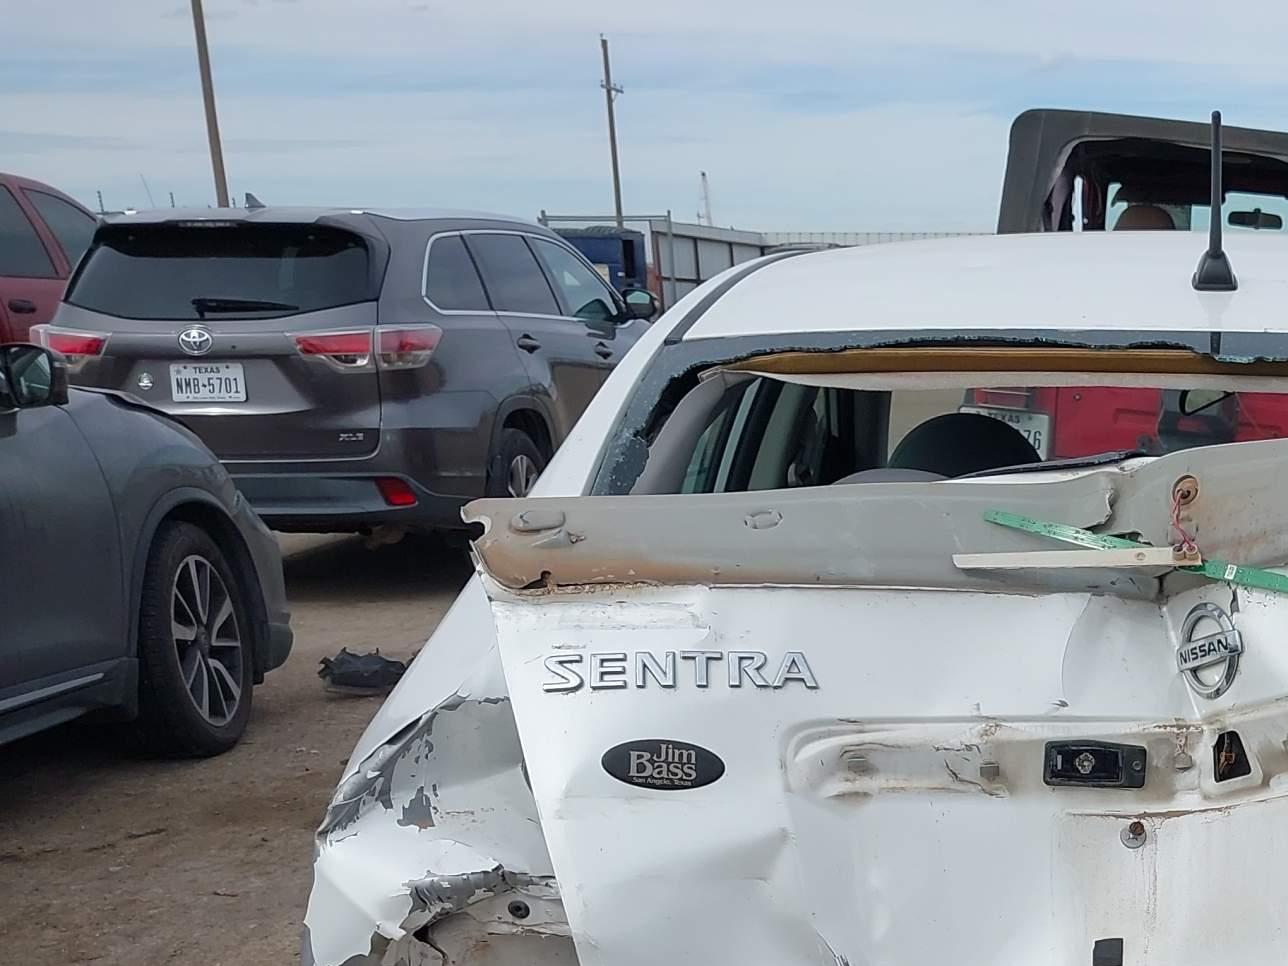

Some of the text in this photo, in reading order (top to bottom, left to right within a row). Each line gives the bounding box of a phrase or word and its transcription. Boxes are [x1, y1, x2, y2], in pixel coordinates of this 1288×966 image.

[1179, 636, 1229, 665] NISSAN
[543, 651, 819, 692] SENTRA
[628, 751, 697, 780] Bass
[652, 743, 697, 764] Jim
